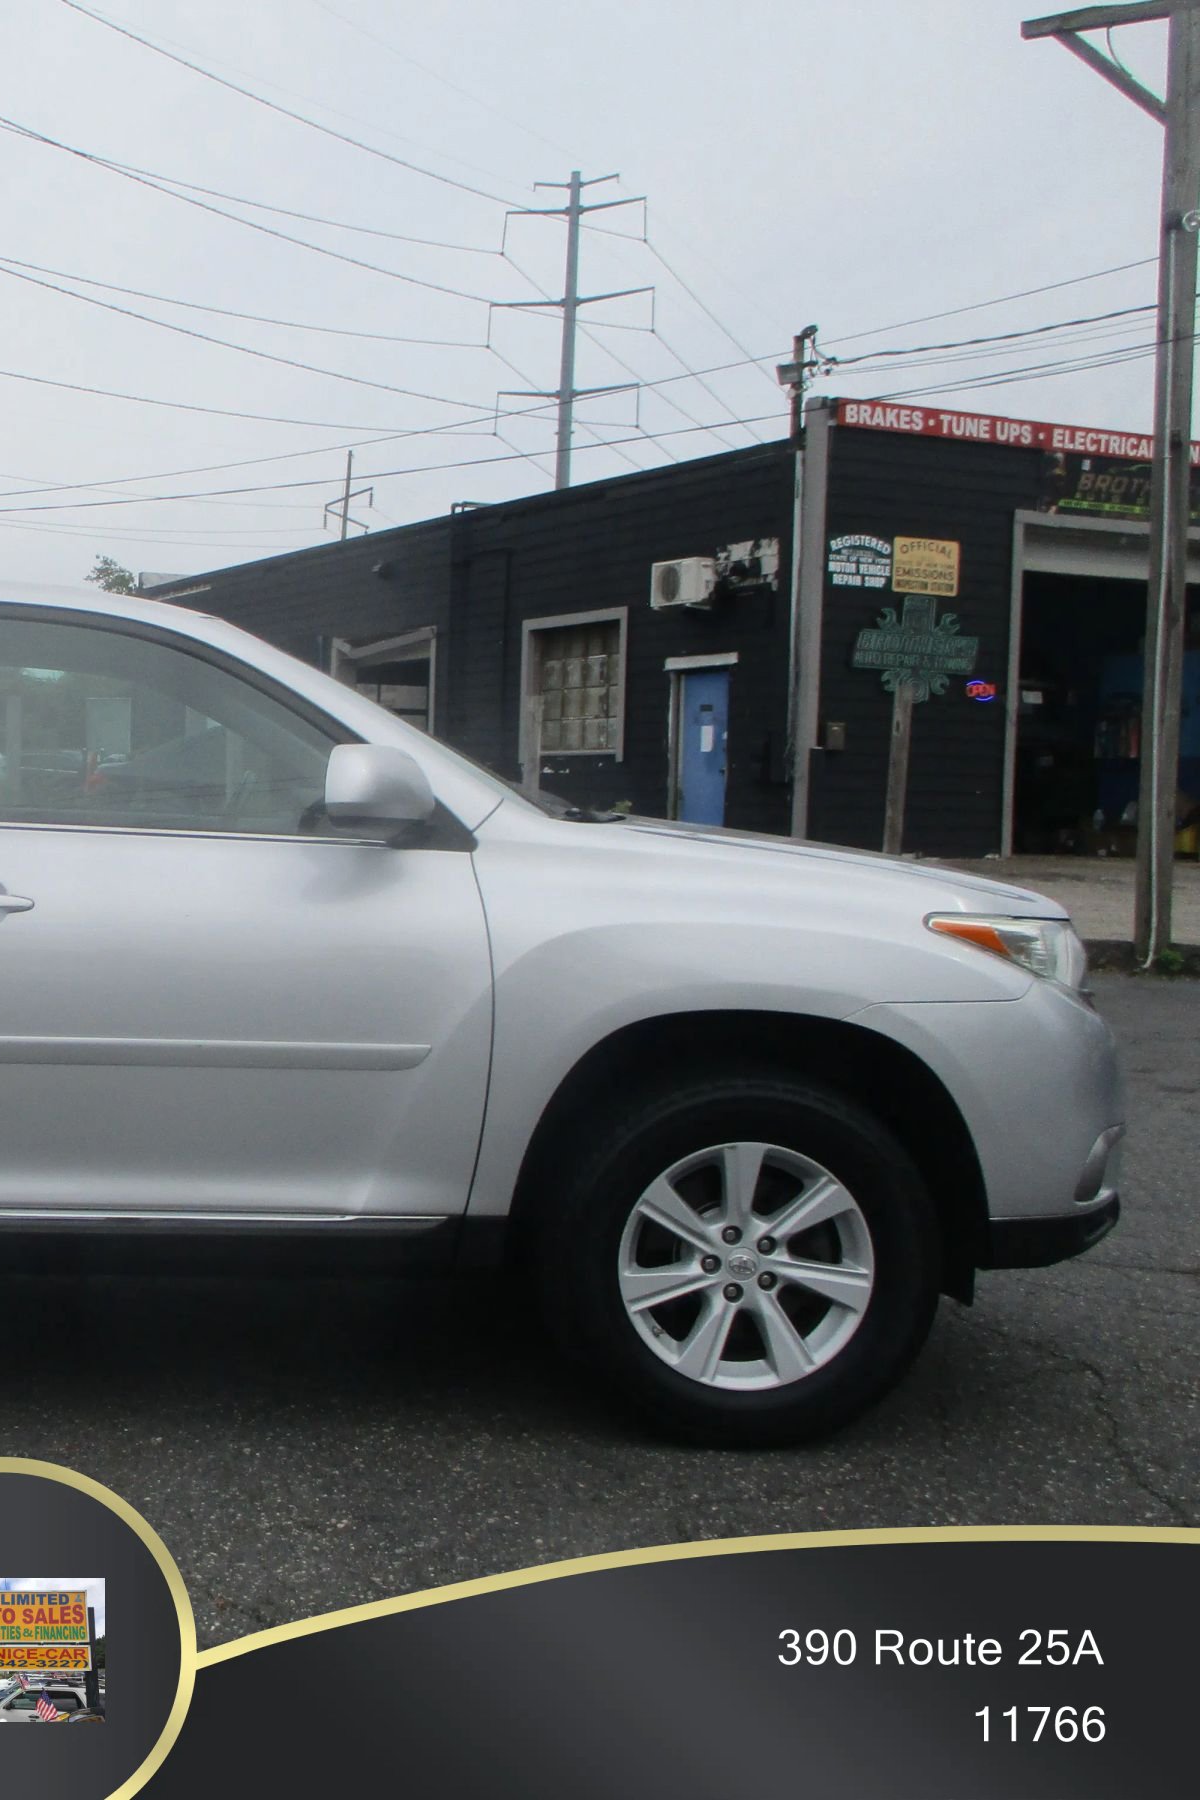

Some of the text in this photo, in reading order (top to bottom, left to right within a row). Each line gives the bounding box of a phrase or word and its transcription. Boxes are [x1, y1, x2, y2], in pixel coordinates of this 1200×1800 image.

[845, 404, 924, 431] BRAKES
[939, 414, 990, 439] TUNE
[995, 421, 1032, 445] UPS
[830, 534, 892, 555] REGISTERED
[899, 541, 952, 559] OFFICIAL
[828, 561, 857, 573] MOTOR
[859, 564, 891, 577] VEHICLE
[896, 566, 954, 581] EMISSIONS
[832, 573, 886, 588] REPAIR SHOP
[966, 683, 997, 697] OPEN
